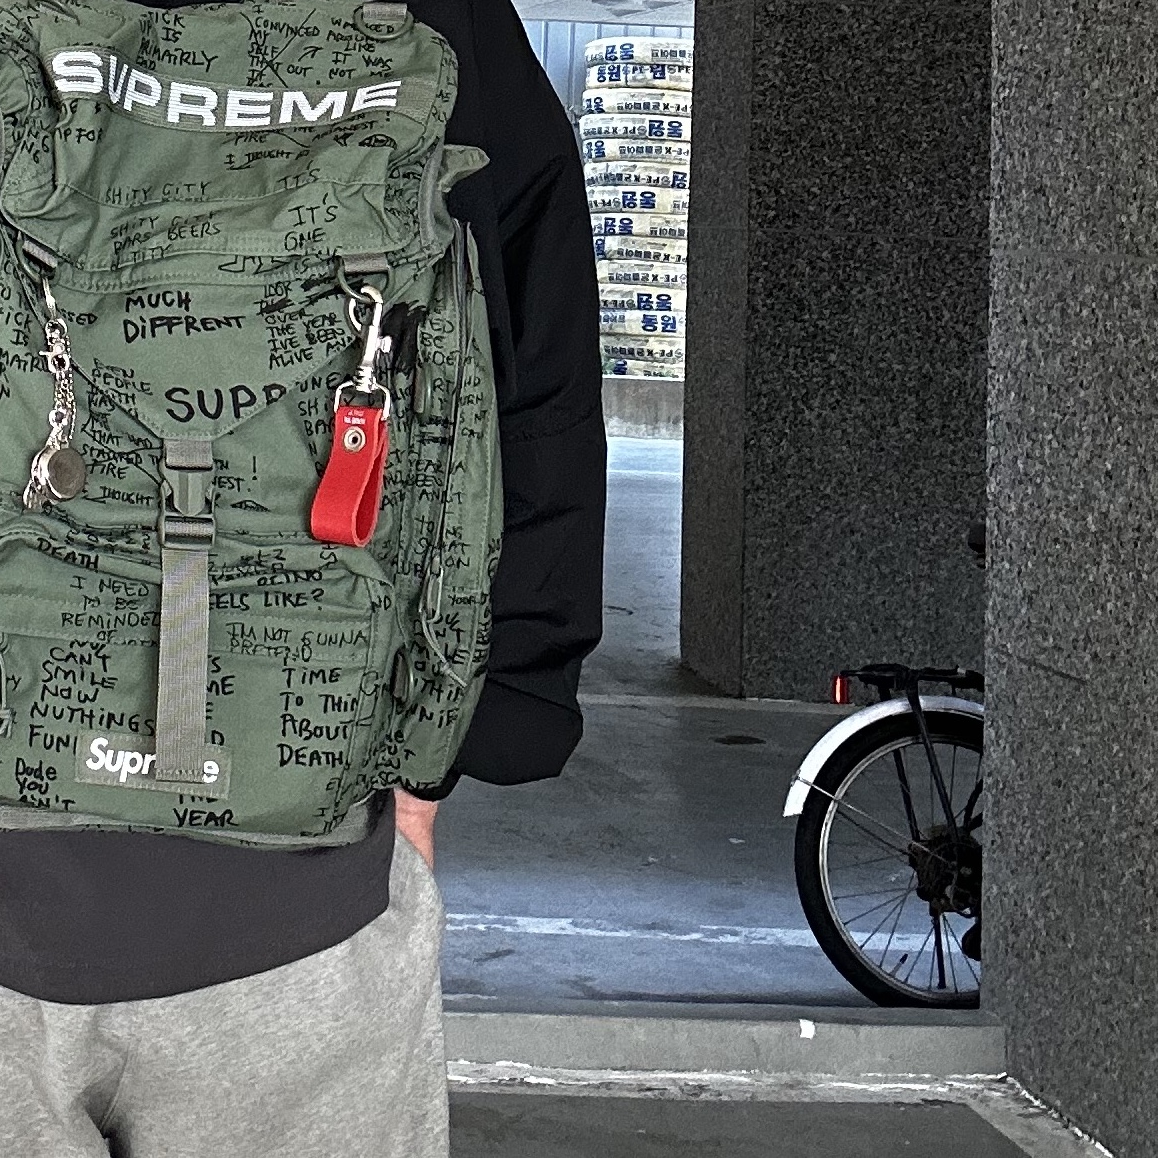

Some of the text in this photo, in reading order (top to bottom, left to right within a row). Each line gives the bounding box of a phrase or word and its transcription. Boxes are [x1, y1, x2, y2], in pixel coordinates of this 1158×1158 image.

[161, 26, 183, 44] IS
[286, 63, 314, 78] OUT
[328, 67, 357, 80] NOT
[52, 50, 402, 128] SUPREME
[648, 120, 683, 139] 동원
[288, 192, 338, 227] IT'S
[622, 191, 657, 209] 동원
[125, 290, 192, 313] MUCH
[637, 293, 673, 311] 동원
[642, 314, 678, 333] 동원
[99, 577, 150, 597] NEED
[264, 625, 292, 643] NOT
[40, 683, 100, 704] NOW
[279, 691, 305, 712] TO
[280, 712, 351, 741] ABOUT
[276, 742, 345, 769] DEATH
[172, 808, 240, 829] YEAR
